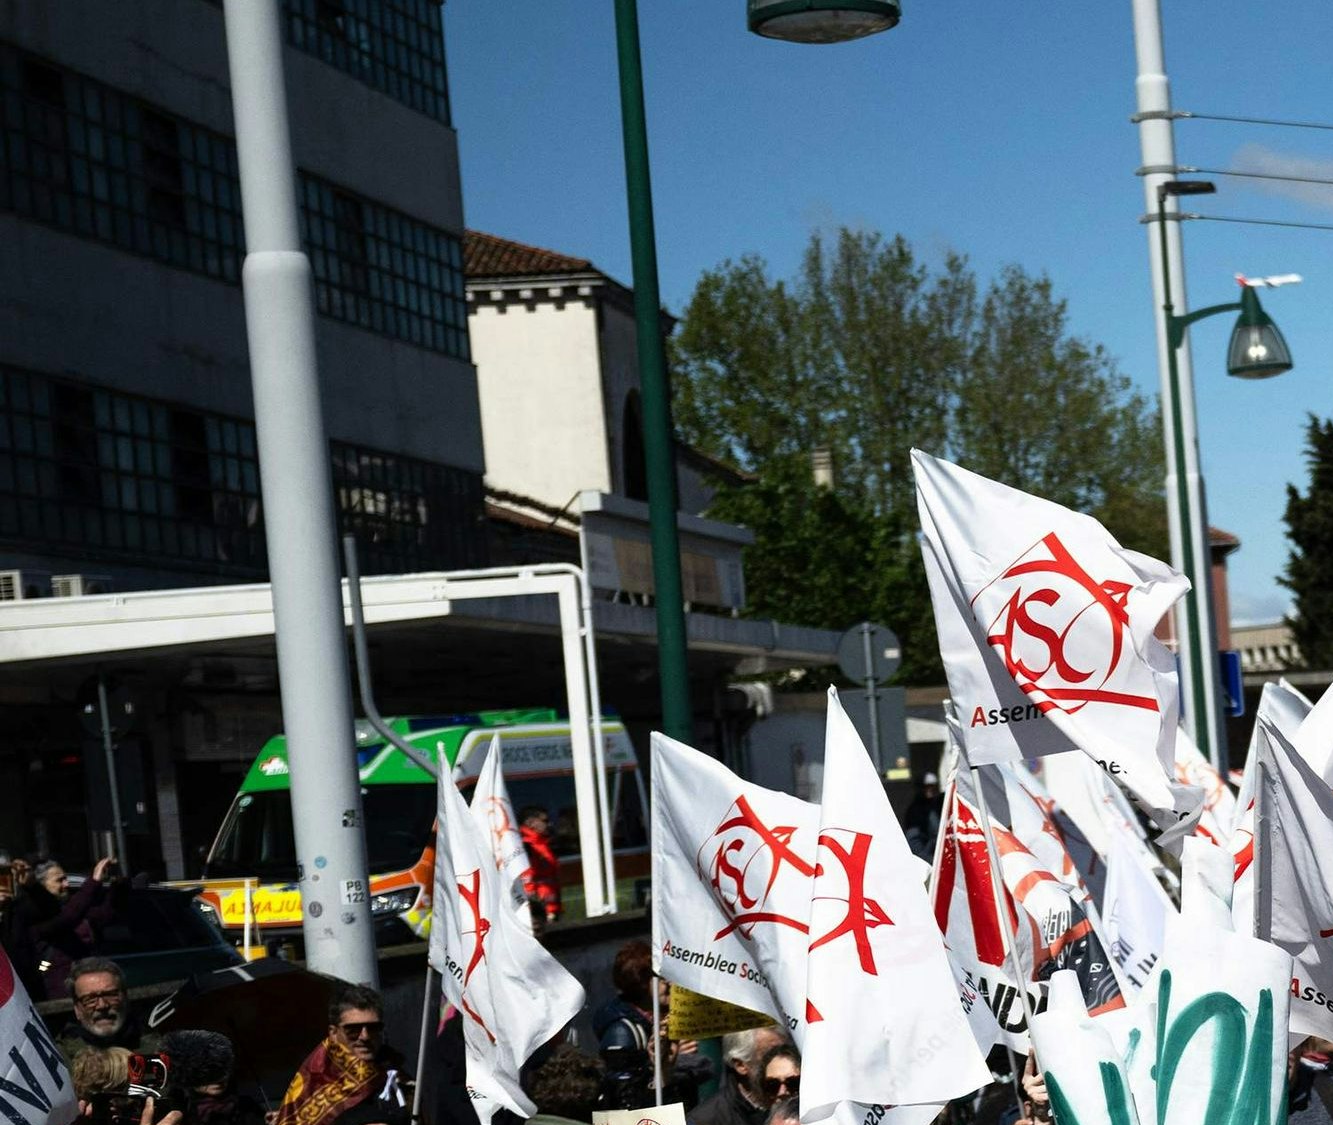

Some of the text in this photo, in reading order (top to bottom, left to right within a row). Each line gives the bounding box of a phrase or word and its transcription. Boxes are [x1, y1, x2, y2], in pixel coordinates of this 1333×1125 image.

[346, 880, 363, 892] PB
[347, 893, 365, 904] 122
[662, 939, 737, 976] Assemblea
